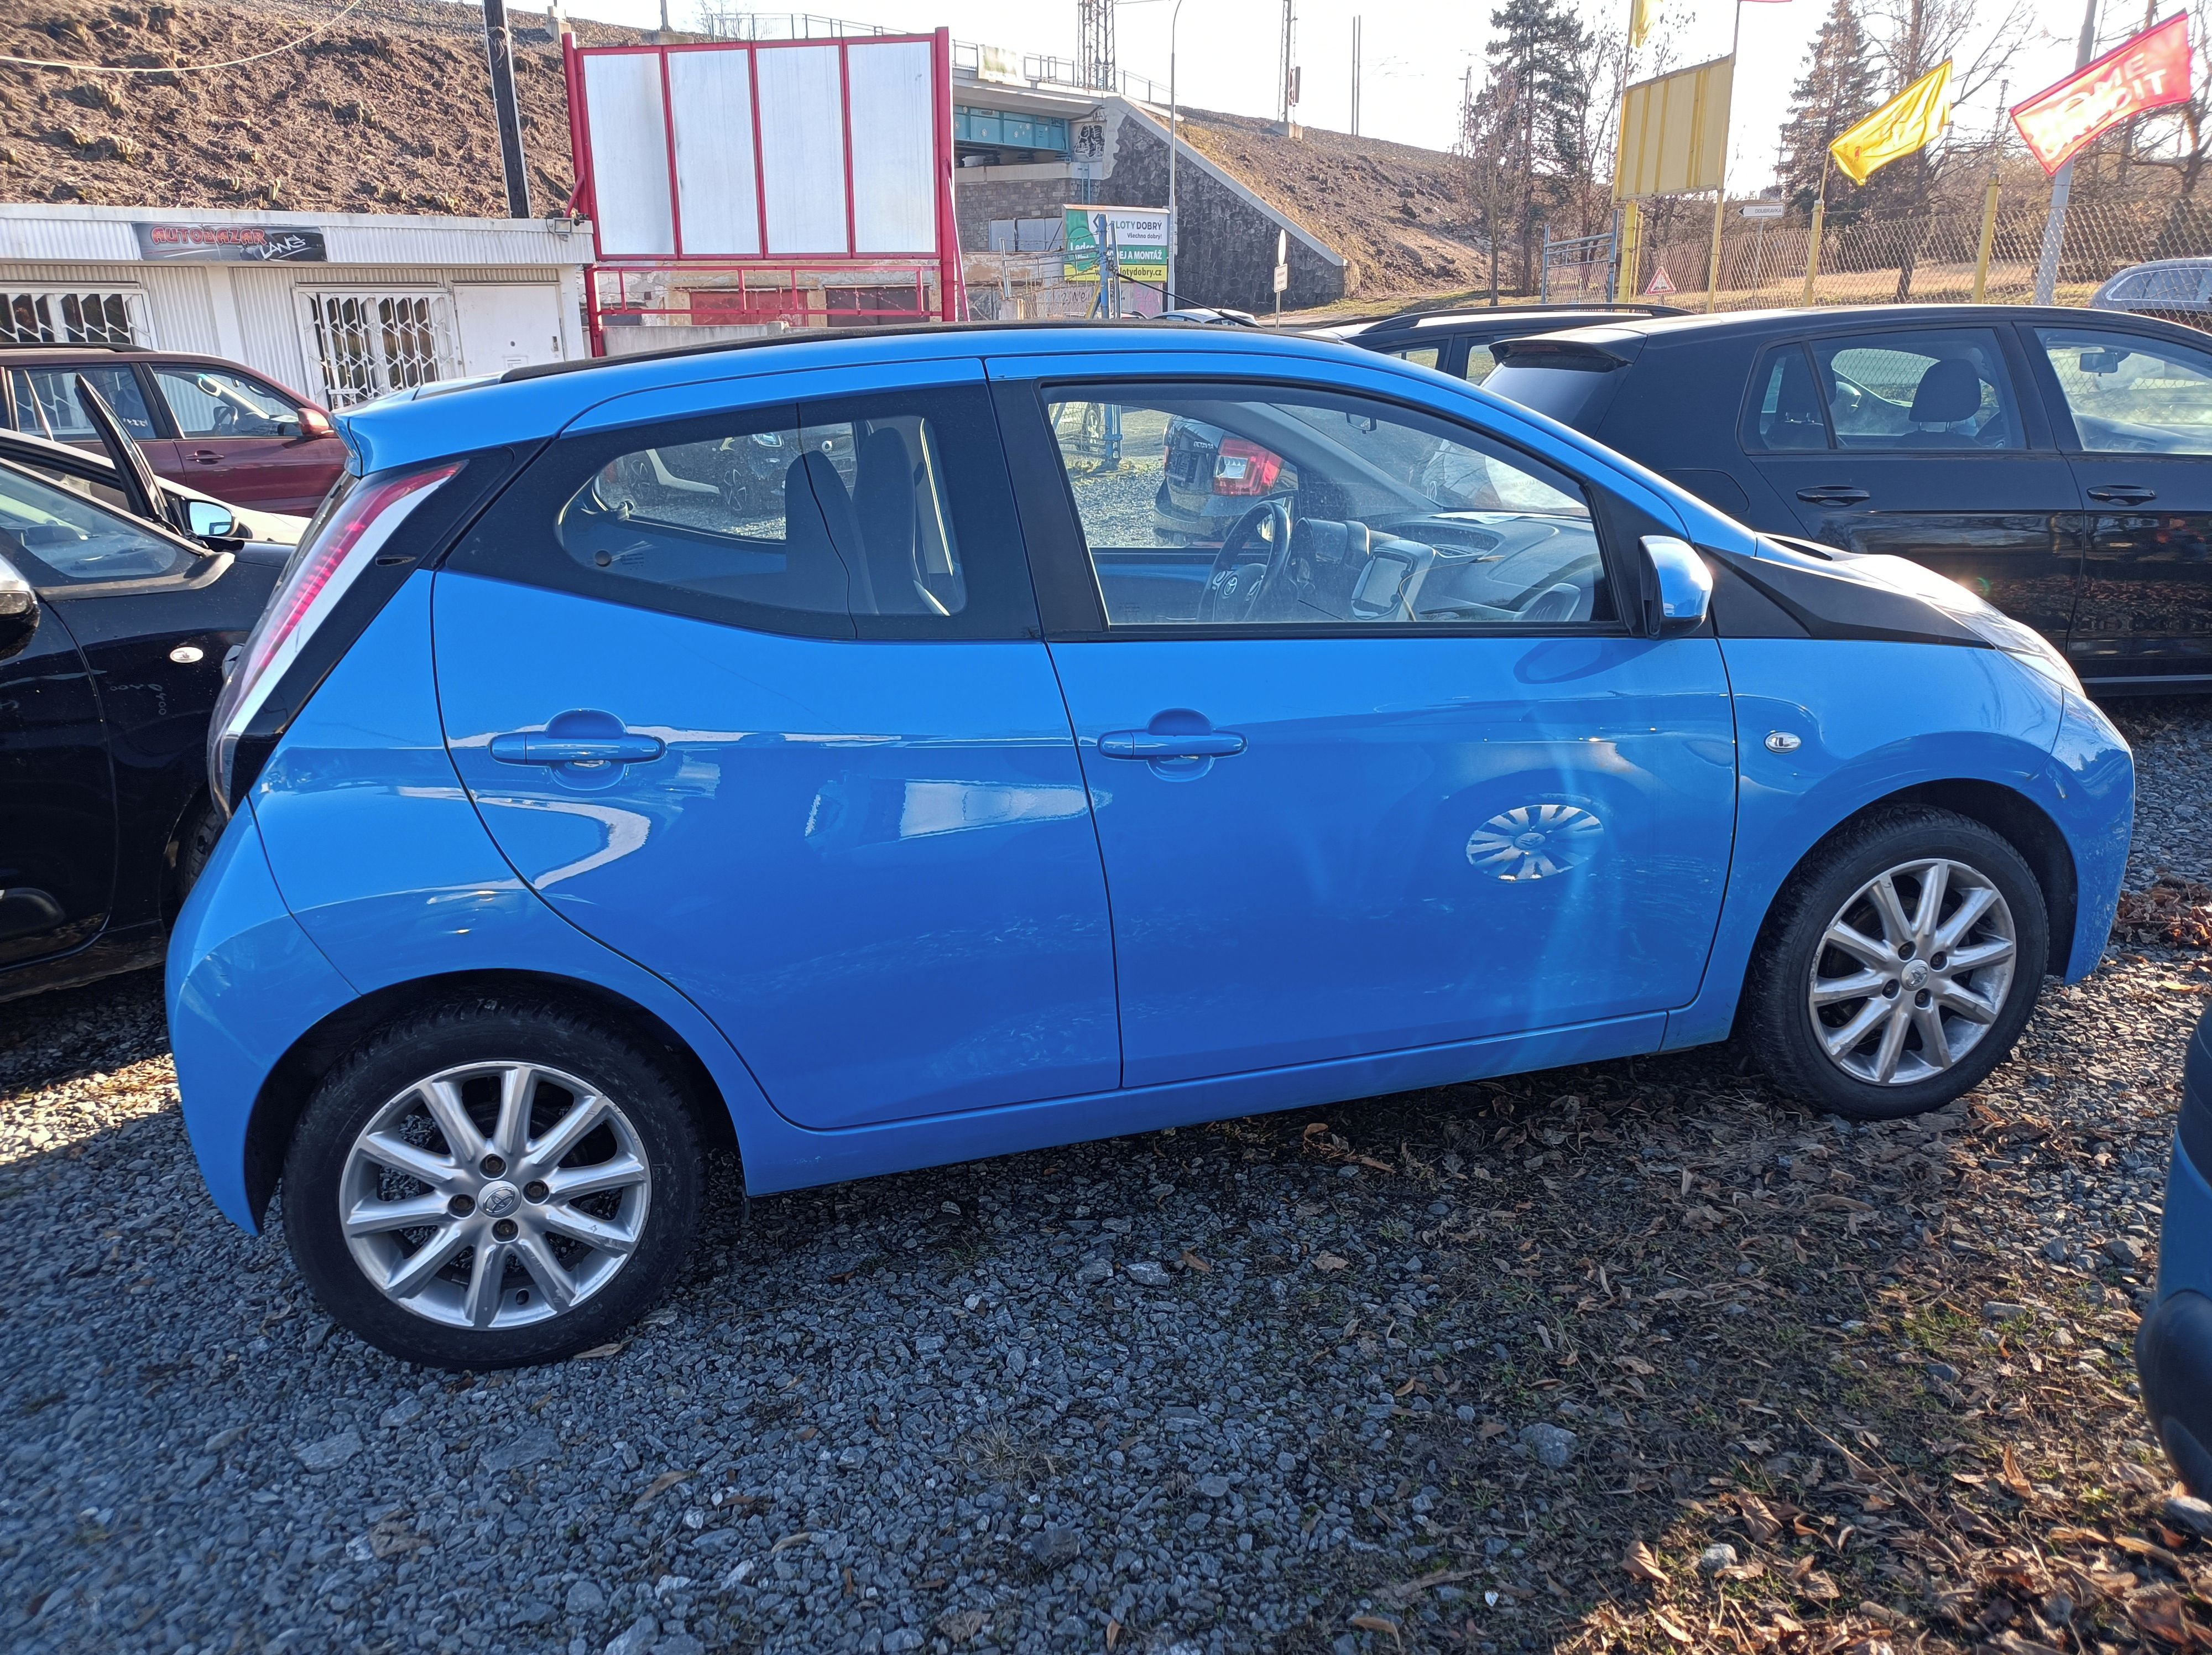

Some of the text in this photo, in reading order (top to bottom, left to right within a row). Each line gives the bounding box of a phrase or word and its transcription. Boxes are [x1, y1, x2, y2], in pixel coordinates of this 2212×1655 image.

[1111, 220, 1162, 230] LOTY DOBRÝ
[151, 226, 268, 246] AUTOBAZAR
[259, 234, 306, 259] LANG
[1128, 251, 1133, 259] A
[1134, 249, 1162, 260] MONTÁŽ
[1193, 441, 1214, 449] OCTAVIA
